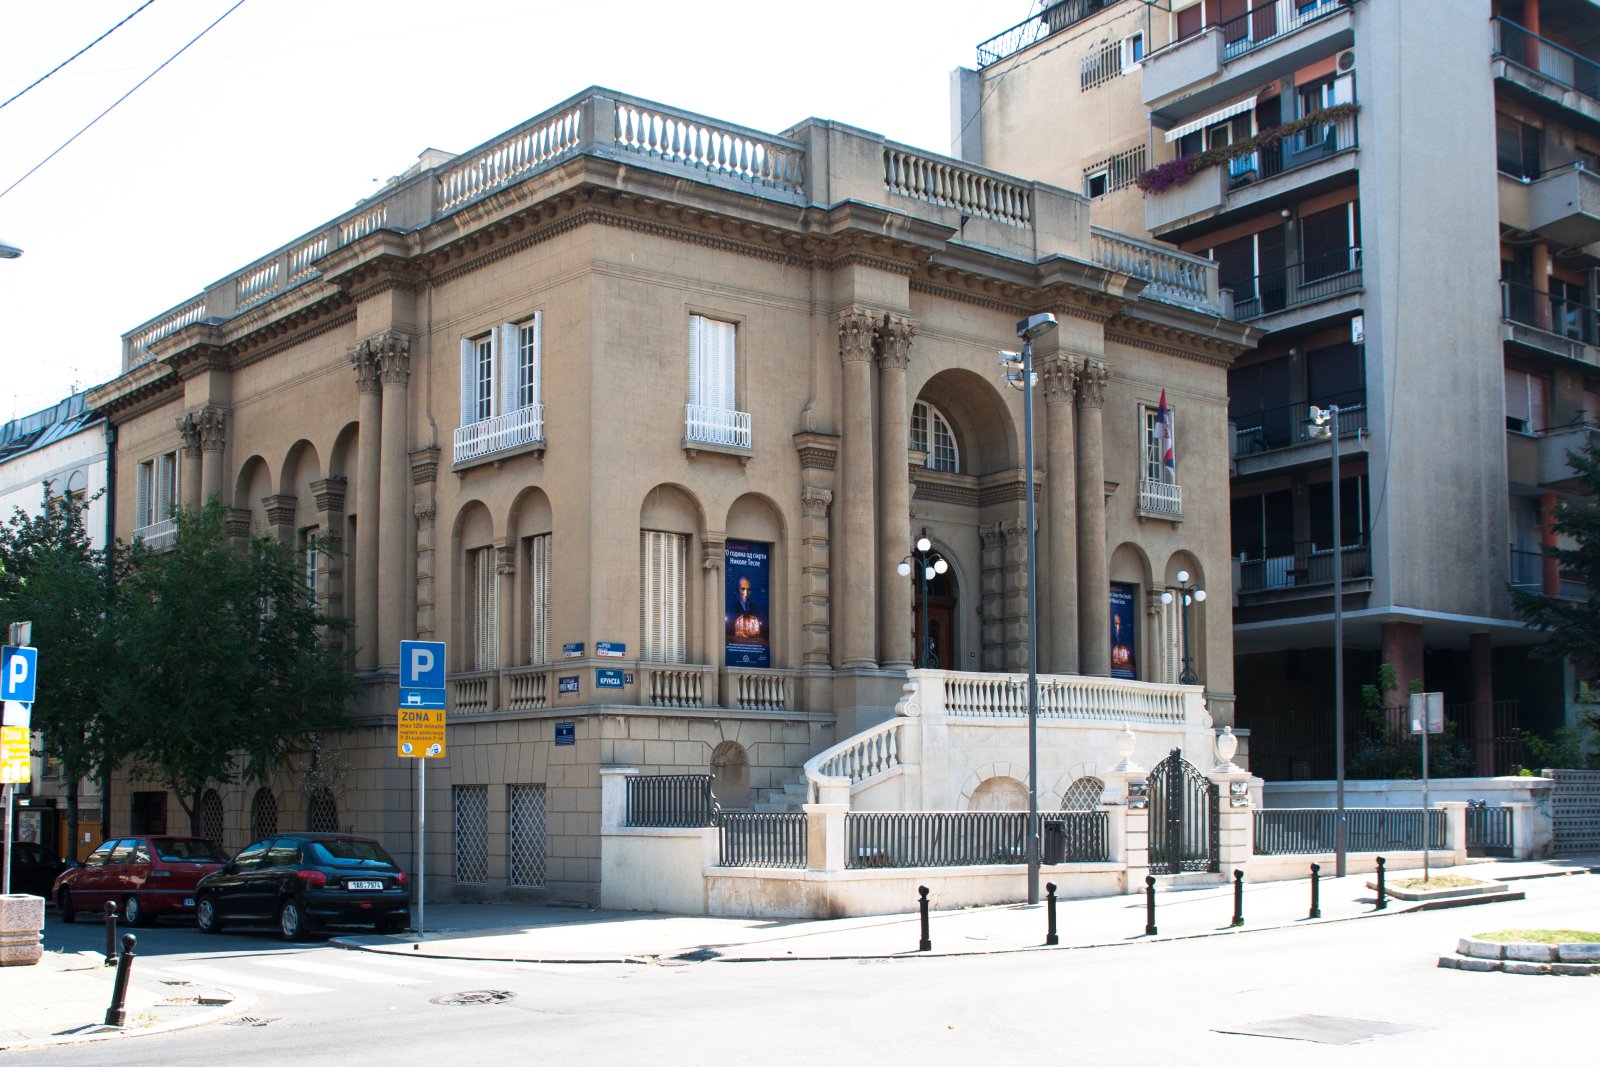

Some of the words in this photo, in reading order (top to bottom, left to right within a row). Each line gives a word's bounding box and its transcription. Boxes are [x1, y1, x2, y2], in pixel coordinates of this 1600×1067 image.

[9, 655, 28, 693] P
[411, 648, 434, 681] P
[402, 712, 430, 722] ZONA
[436, 712, 442, 722] II
